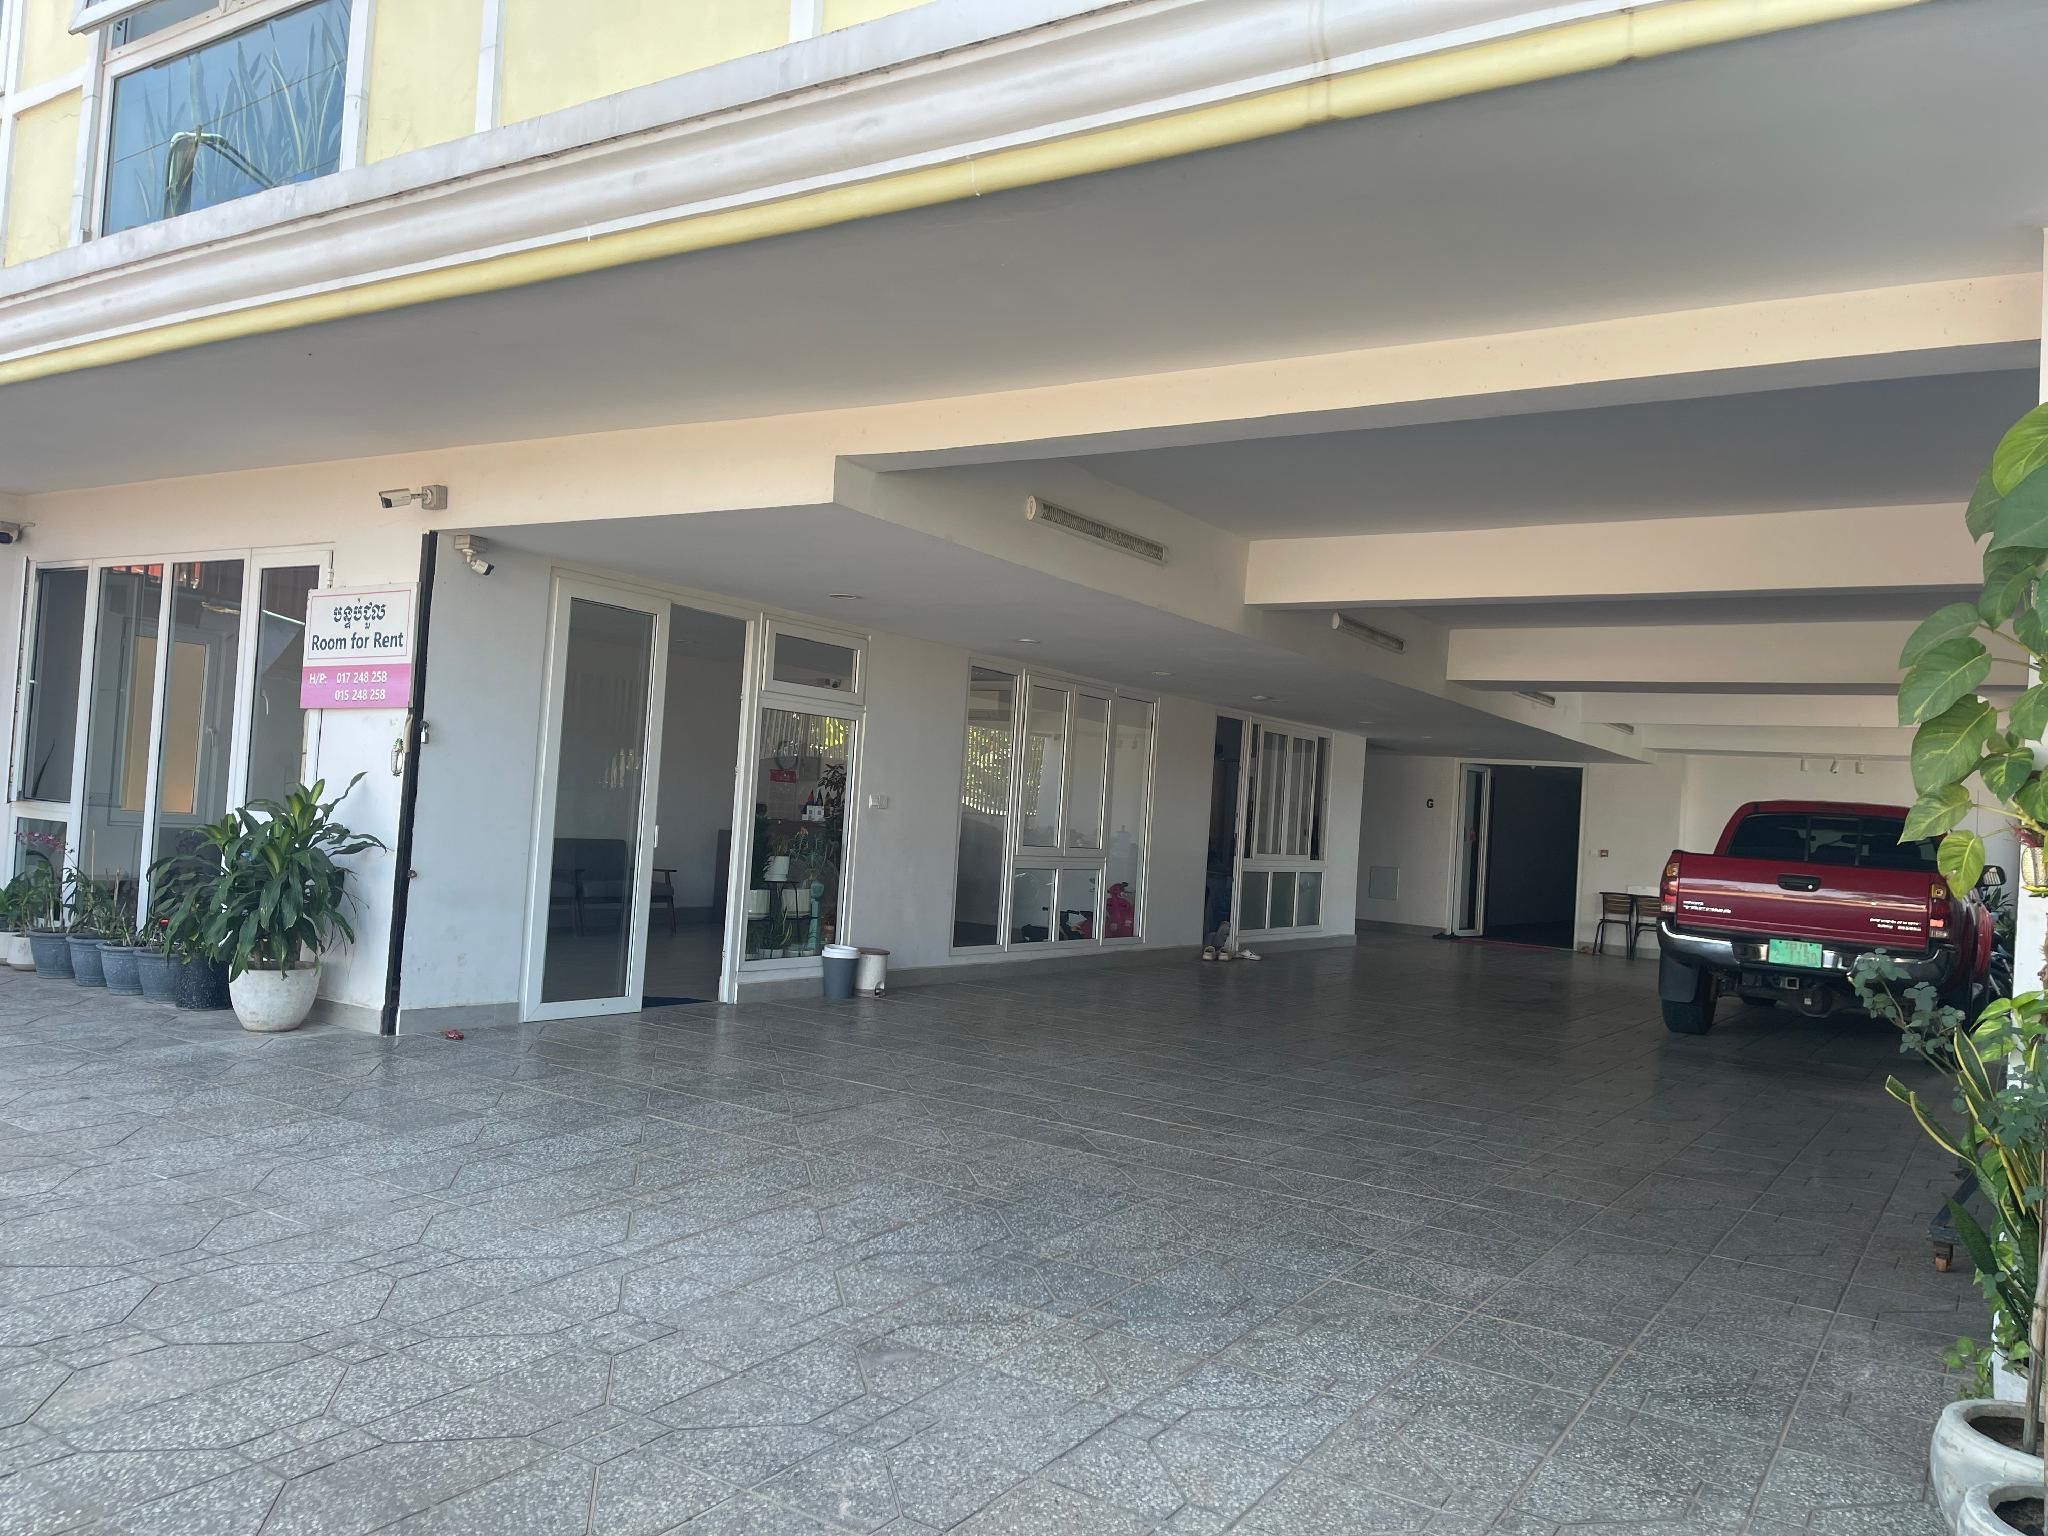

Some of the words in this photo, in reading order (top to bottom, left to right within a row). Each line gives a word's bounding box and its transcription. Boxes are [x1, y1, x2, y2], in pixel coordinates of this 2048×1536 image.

[312, 634, 347, 651] Room
[351, 632, 370, 649] for
[373, 631, 404, 648] Rent
[336, 672, 350, 684] 017
[353, 671, 369, 683] 248
[371, 670, 388, 683] 258
[335, 690, 349, 701] 015
[352, 690, 368, 701] 248
[370, 689, 386, 700] 258
[1427, 799, 1434, 808] G
